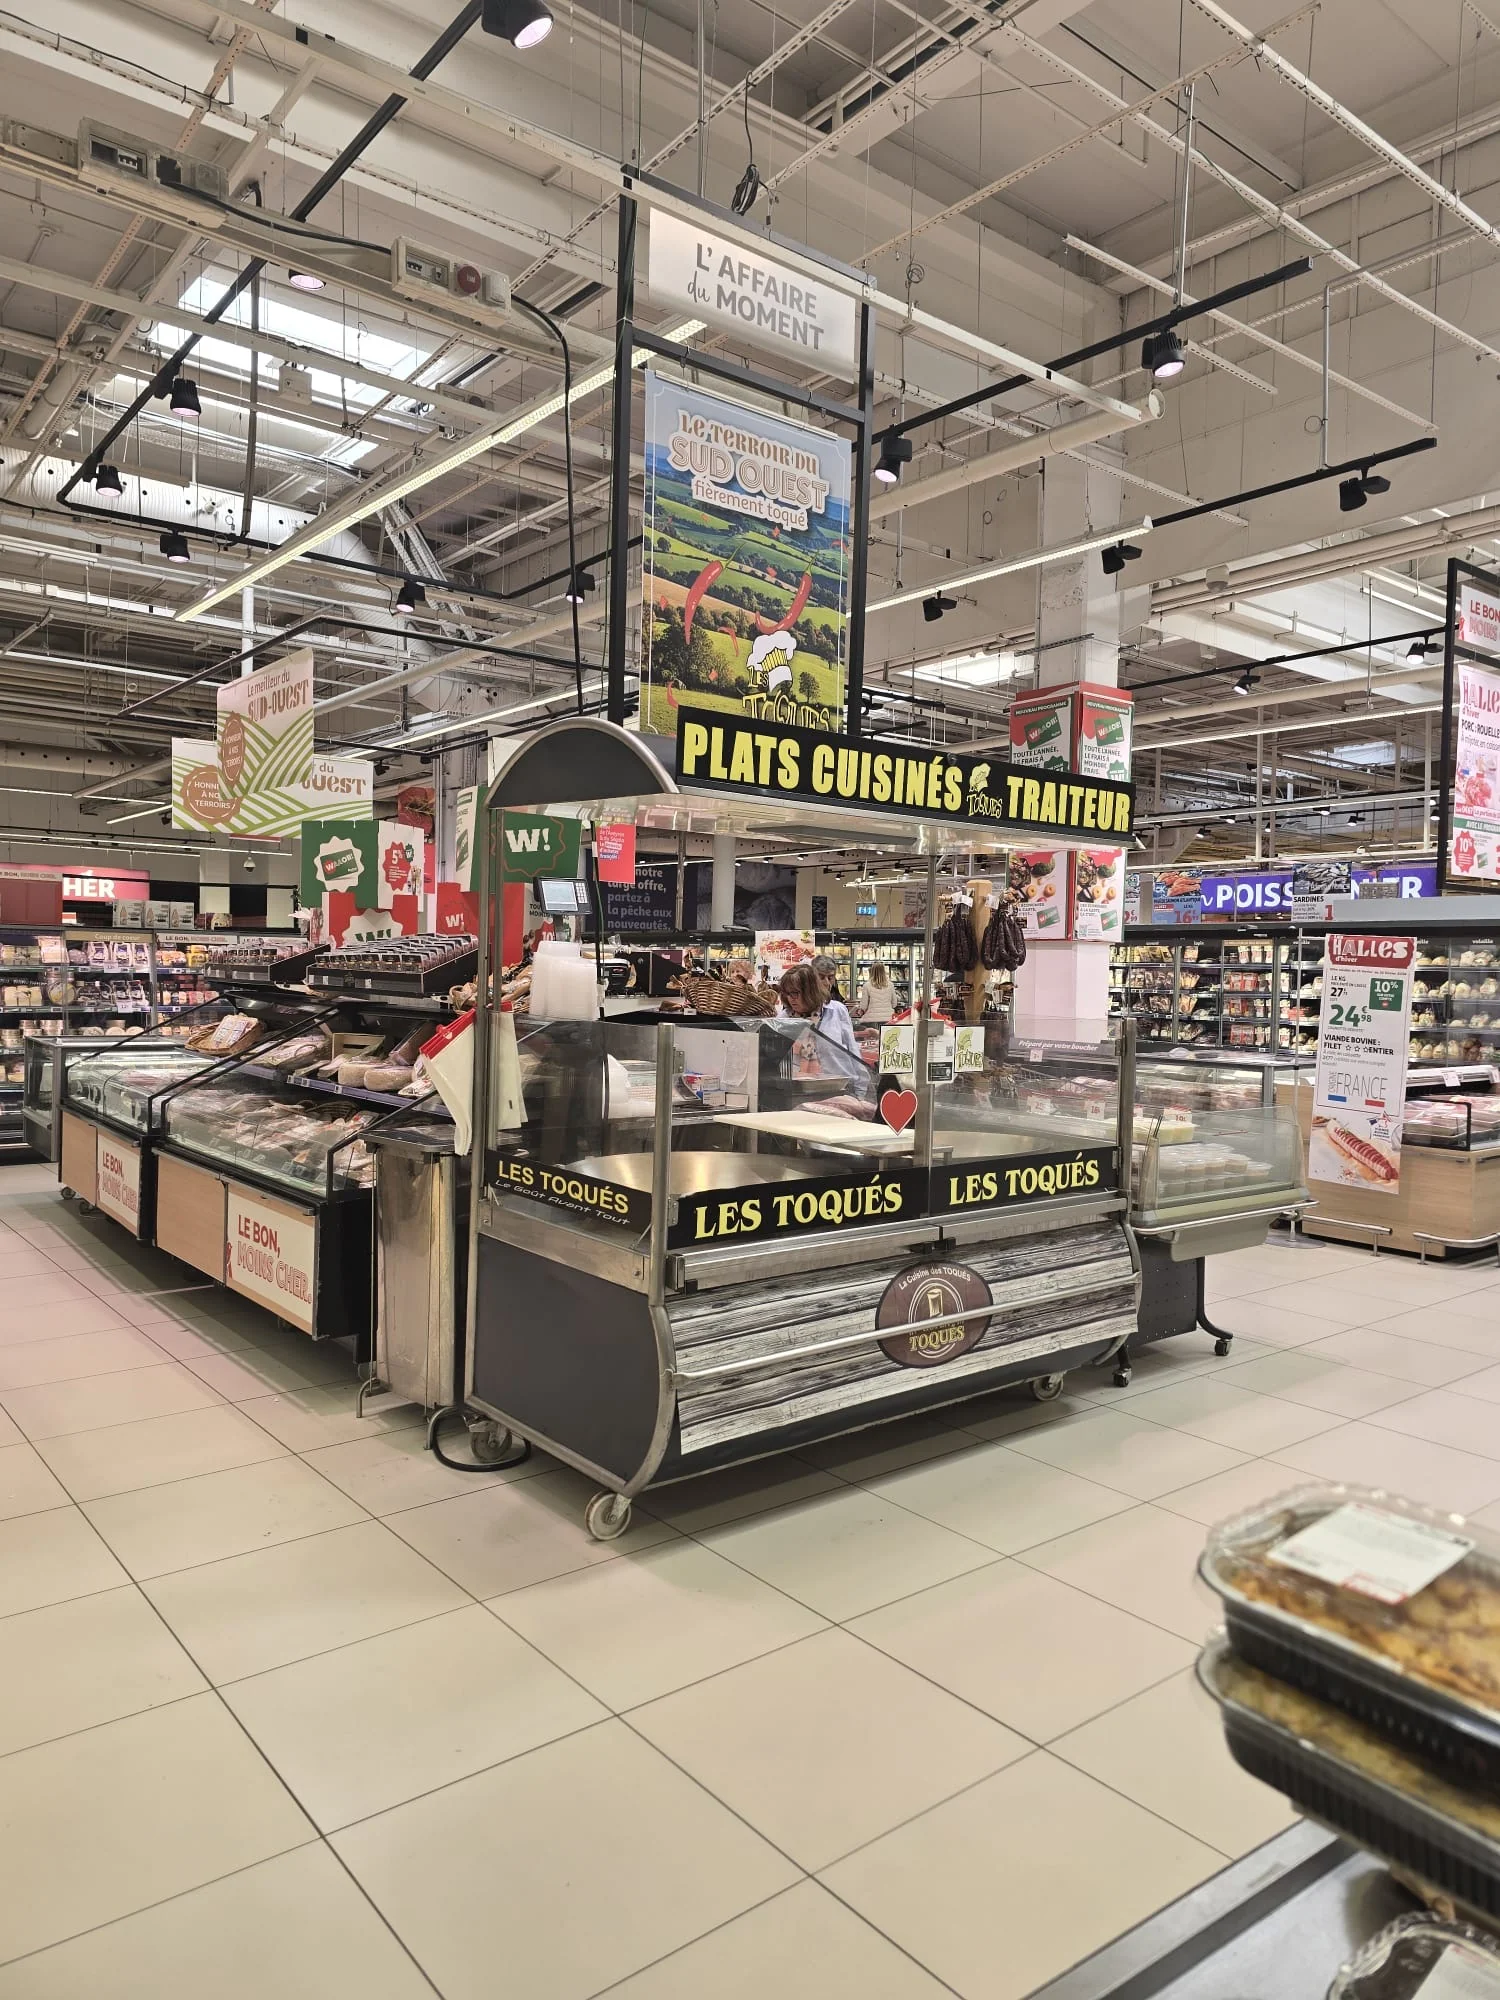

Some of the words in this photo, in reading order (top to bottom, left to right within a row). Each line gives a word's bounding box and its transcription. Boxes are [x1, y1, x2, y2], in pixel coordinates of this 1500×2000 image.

[687, 270, 710, 304] du
[716, 284, 824, 350] MOMENT
[710, 425, 792, 466] TERROIR
[794, 452, 817, 475] DU
[672, 435, 732, 479] SUD
[739, 458, 827, 510] OUEST
[694, 479, 764, 515] fièrement
[768, 502, 806, 528] toqué
[1470, 600, 1480, 615] LE
[254, 674, 280, 696] meilleur
[281, 670, 290, 685] du
[747, 666, 769, 688] LES
[319, 762, 334, 773] du
[683, 722, 800, 791] PLATS
[812, 743, 962, 812] CUISINÉS
[195, 799, 231, 809] TERROIRS
[1006, 775, 1130, 833] TRAITEUR
[505, 828, 551, 853] W!
[635, 867, 663, 877] notre
[608, 893, 642, 903] partez
[644, 892, 650, 903] à
[638, 880, 666, 893] offre,
[621, 905, 651, 918] pêche
[653, 908, 672, 917] aux
[1175, 910, 1193, 924] 16
[1333, 938, 1408, 959] HALLES
[1330, 987, 1343, 997] 27
[1329, 1004, 1360, 1027] 24
[1361, 1014, 1372, 1023] 98
[1018, 1039, 1041, 1050] Préparé
[1041, 1043, 1054, 1051] par
[1072, 1043, 1098, 1051] boucher
[1323, 1042, 1341, 1050] FILET
[1369, 1047, 1394, 1055] ENTIER
[1324, 1034, 1350, 1043] VIANDE
[1351, 1036, 1377, 1045] BOVINE
[1337, 1072, 1388, 1100] FRANCE
[102, 1152, 109, 1168] LE
[499, 1160, 534, 1186] LES
[539, 1171, 629, 1214] TOQUÉS
[949, 1172, 998, 1206] LES
[1004, 1152, 1100, 1197] TOQUÉS
[495, 1179, 511, 1188] Le
[514, 1184, 545, 1199] Goût
[548, 1196, 592, 1213] Avant
[595, 1209, 630, 1225] Tout
[694, 1198, 762, 1239] LES
[773, 1175, 903, 1227] TOQUÉS
[238, 1214, 250, 1239] LE
[252, 1221, 281, 1258] BON,
[237, 1241, 273, 1283] MOINS
[276, 1260, 312, 1305] CHER.
[898, 1281, 908, 1290] La
[906, 1270, 929, 1283] Cuisine
[931, 1267, 942, 1275] des
[943, 1266, 971, 1281] TOQUÉS
